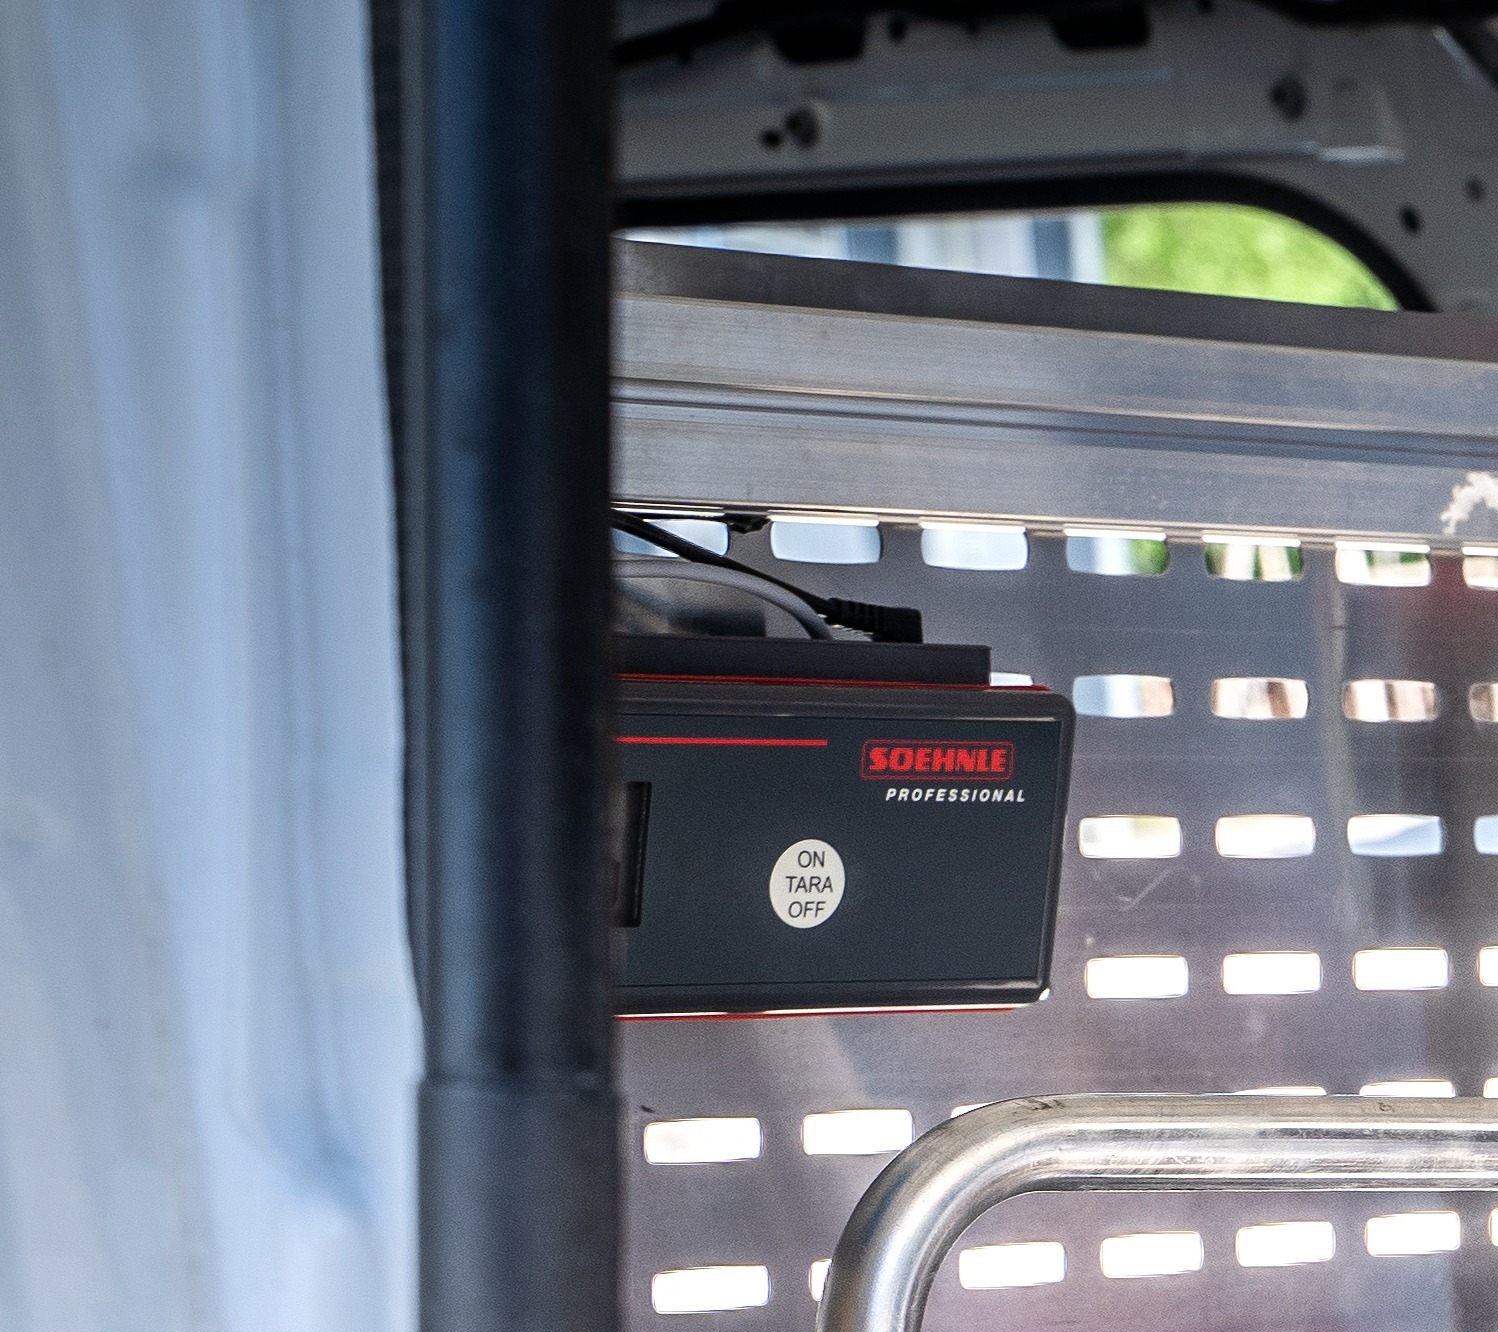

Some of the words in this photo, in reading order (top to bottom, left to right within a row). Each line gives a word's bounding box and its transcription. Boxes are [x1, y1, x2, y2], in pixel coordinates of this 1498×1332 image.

[868, 747, 1009, 773] SOEHNLE
[885, 787, 1026, 803] PROFESSIONAL
[797, 850, 826, 868] ON
[785, 876, 834, 894] TARA
[788, 901, 827, 918] OFF
